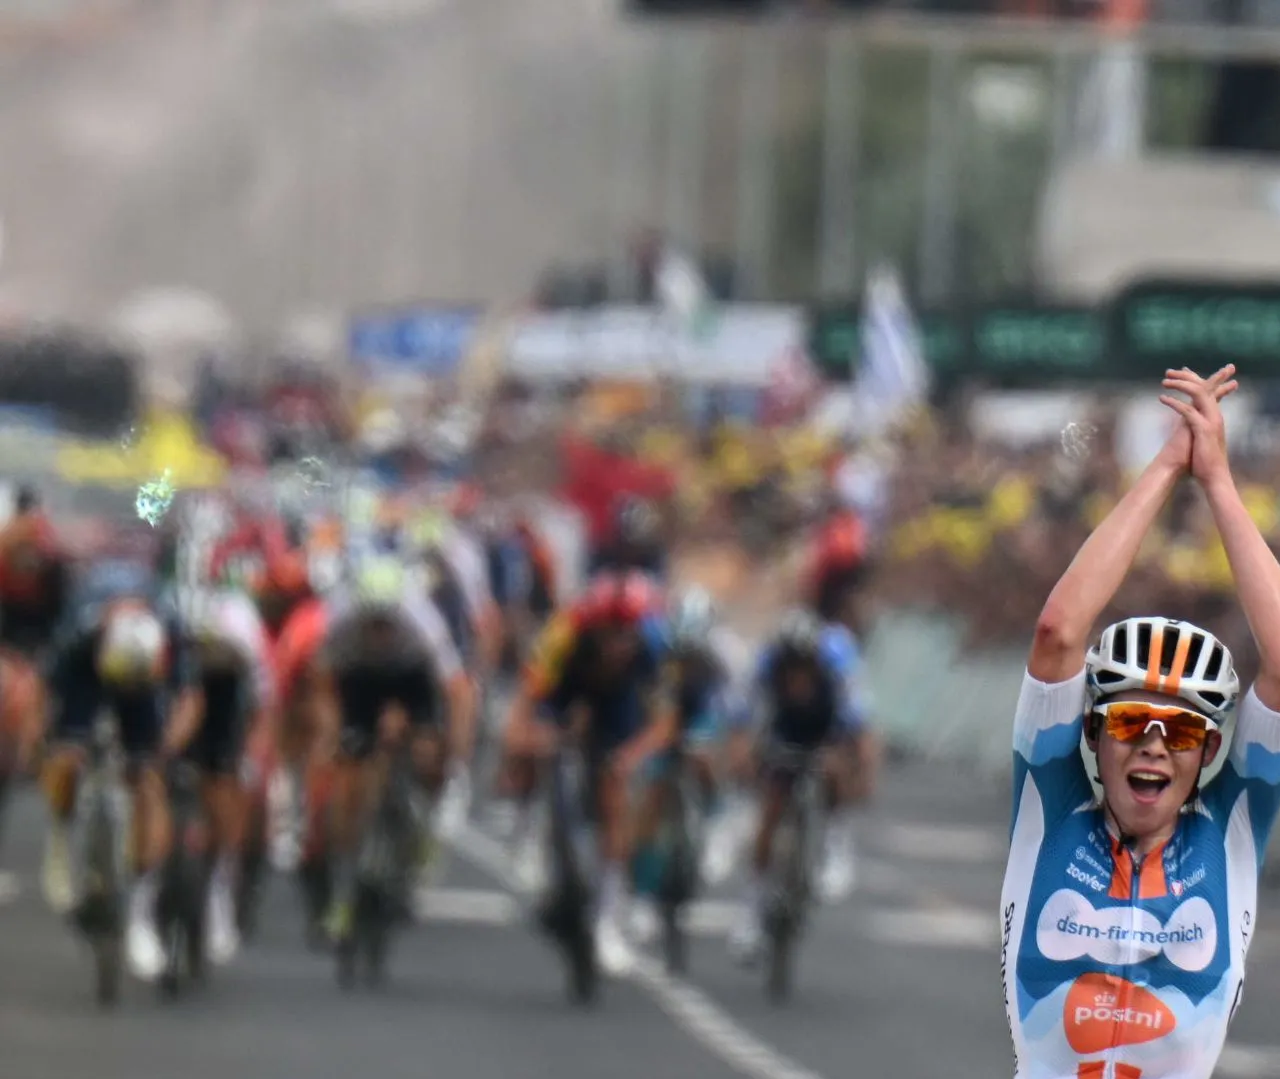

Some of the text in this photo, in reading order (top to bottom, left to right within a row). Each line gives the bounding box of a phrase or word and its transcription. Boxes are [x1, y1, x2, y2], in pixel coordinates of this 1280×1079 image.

[1065, 862, 1108, 892] zoover
[1056, 916, 1204, 944] dsm-firmenich
[1075, 1007, 1163, 1029] postnl
